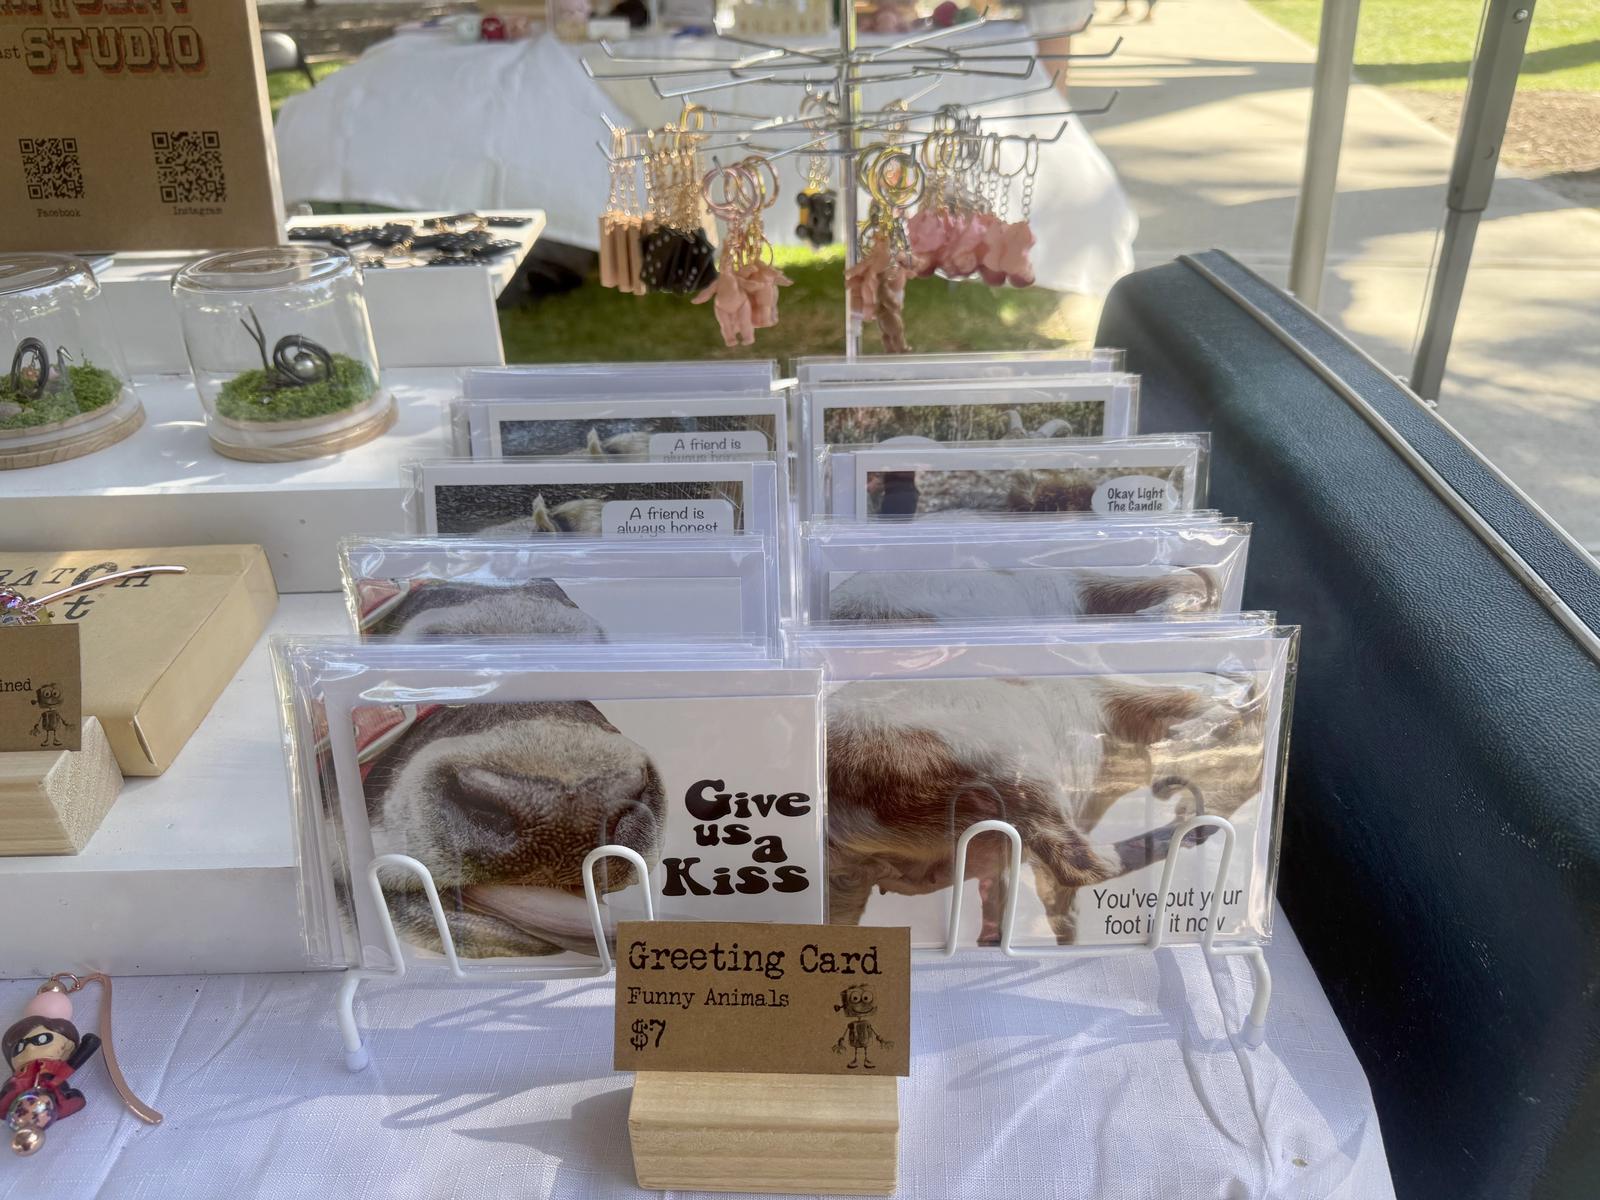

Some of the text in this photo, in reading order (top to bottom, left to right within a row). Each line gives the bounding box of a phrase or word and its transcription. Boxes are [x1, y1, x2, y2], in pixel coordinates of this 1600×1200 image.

[22, 26, 205, 74] STUDIO
[37, 208, 81, 218] Facebook
[172, 206, 223, 217] Instagram
[674, 437, 742, 451] A friend is
[1107, 486, 1165, 501] Okay Light
[629, 506, 705, 521] A friend is
[1107, 500, 1162, 512] The Candle
[617, 521, 718, 537] always honest
[684, 779, 811, 821] Give
[692, 823, 788, 864] us a
[661, 856, 810, 897] Kiss
[1093, 887, 1243, 912] You've put yur
[1105, 915, 1141, 935] foot
[1169, 913, 1181, 933] it
[628, 940, 883, 980] Greeting Card
[626, 986, 790, 1009] Funny Animals
[629, 1018, 667, 1052] $7
